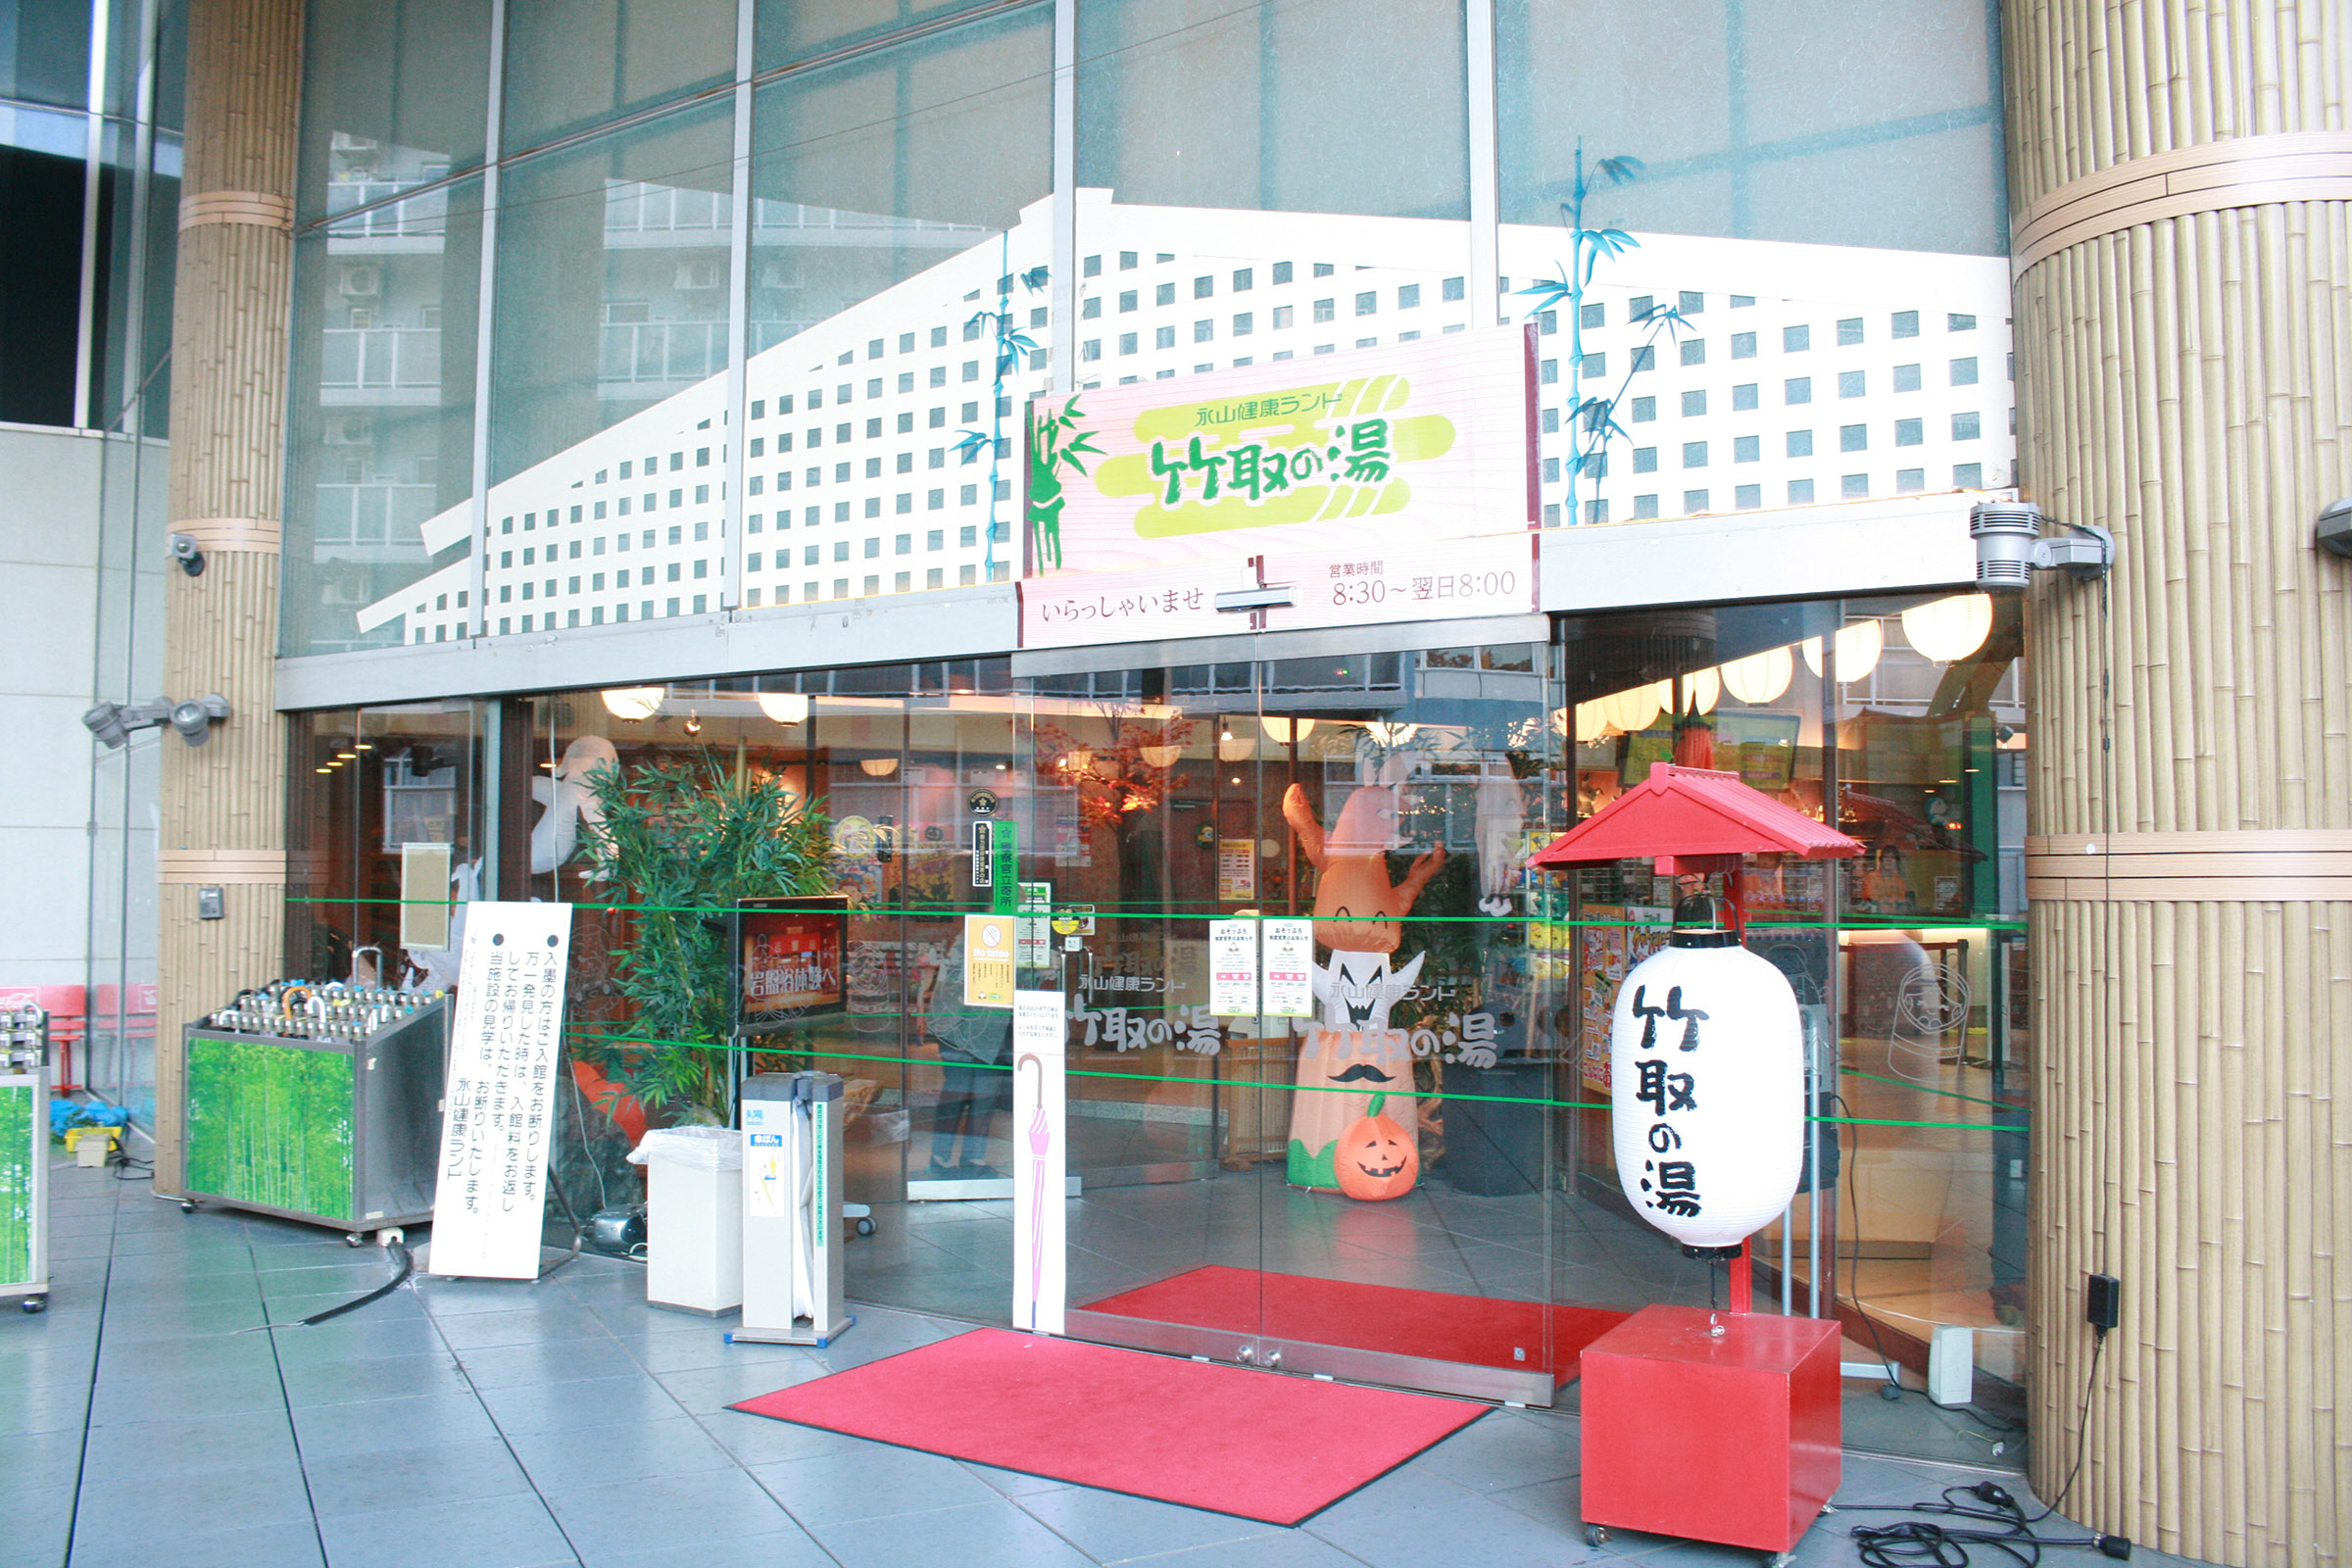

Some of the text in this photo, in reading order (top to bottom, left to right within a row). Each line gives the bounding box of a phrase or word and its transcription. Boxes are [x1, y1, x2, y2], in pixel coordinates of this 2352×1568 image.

[1195, 392, 1344, 427] 永山健康ランド
[1151, 417, 1391, 505] 竹取の湯
[1328, 560, 1384, 579] 営業時間
[1042, 588, 1204, 623] いらっしゃいませ
[1078, 974, 1187, 994] 永山健康ランド
[1330, 981, 1455, 1000] 永山健康ランド
[492, 951, 520, 1131] してお帰りいただきます。
[1293, 1011, 1497, 1069] 竹取の湯
[522, 952, 558, 1200] 入墨の方はご入館をお断りします。
[1632, 984, 1709, 1217] 竹取の湯
[446, 1078, 472, 1181] 永山健康ランド
